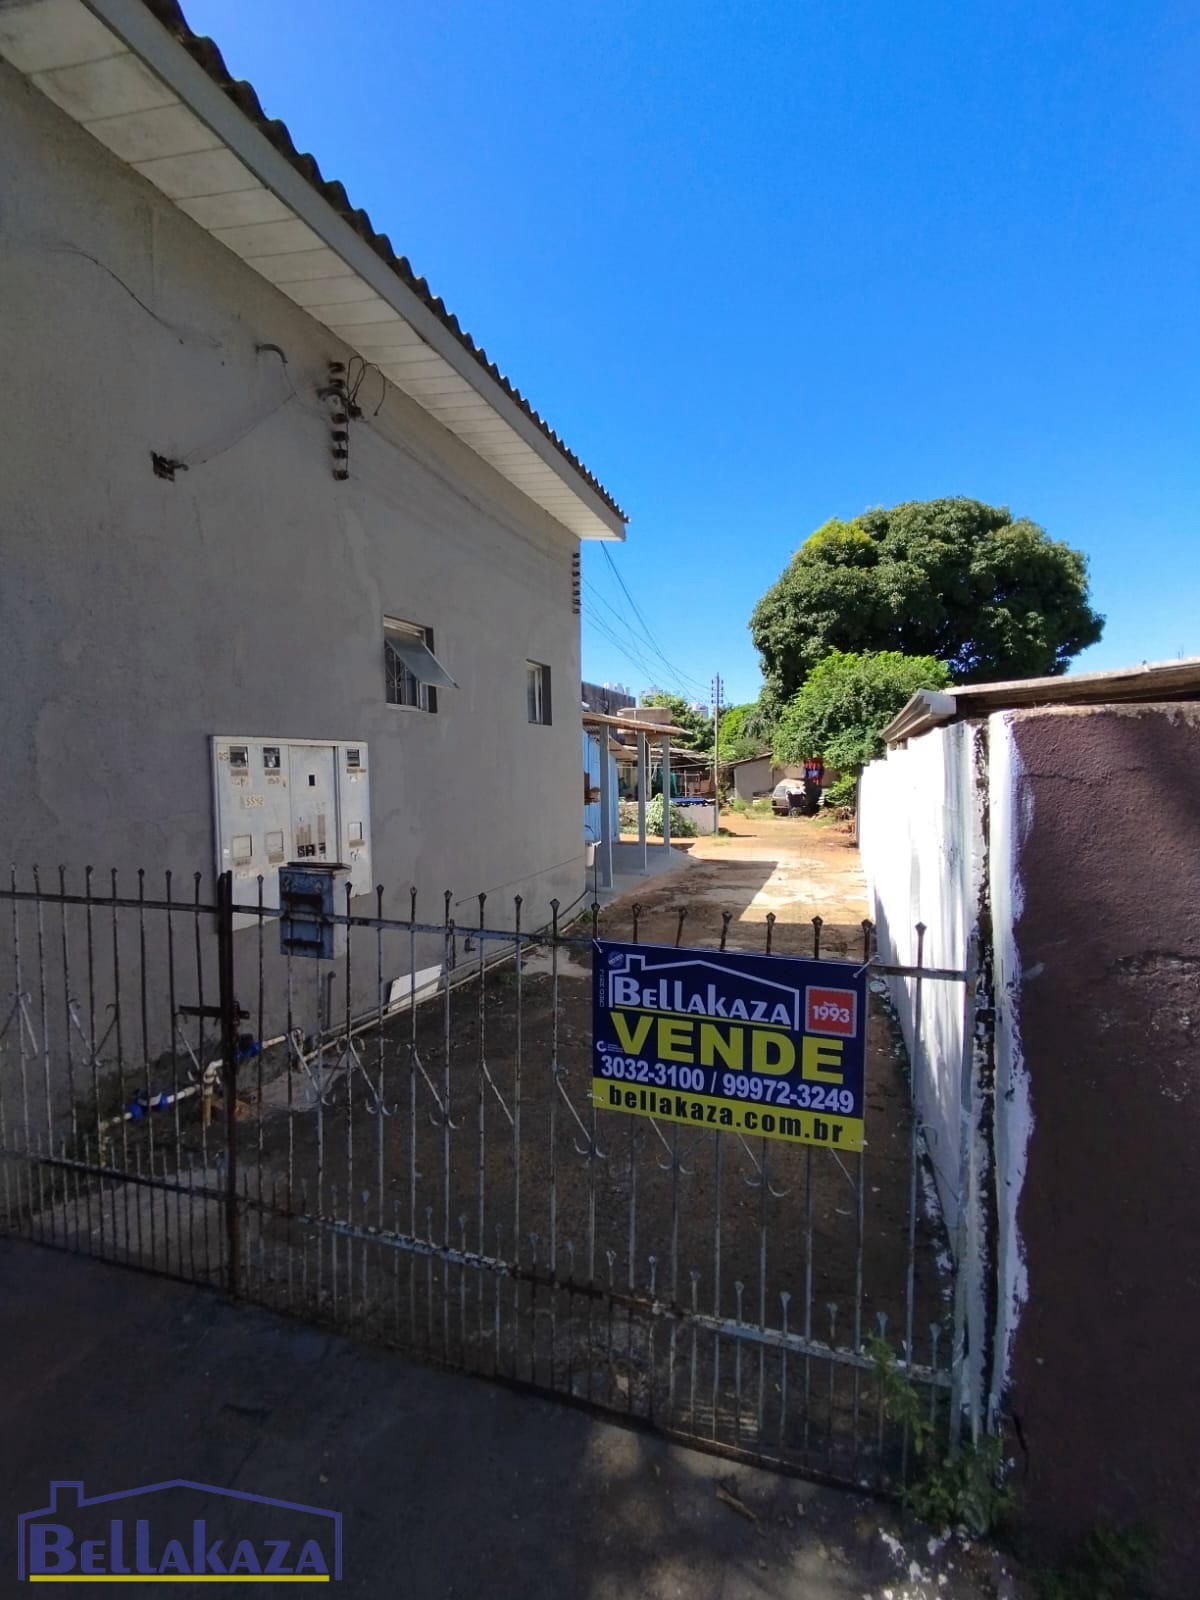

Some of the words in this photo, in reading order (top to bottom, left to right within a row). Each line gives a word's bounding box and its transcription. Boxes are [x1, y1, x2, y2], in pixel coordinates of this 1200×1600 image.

[812, 1004, 850, 1023] 1993
[610, 1011, 844, 1085] VENDE
[600, 1055, 705, 1091] 3032-3100
[722, 1073, 855, 1114] 99972-3249
[609, 1084, 844, 1143] bellakaza.com.br
